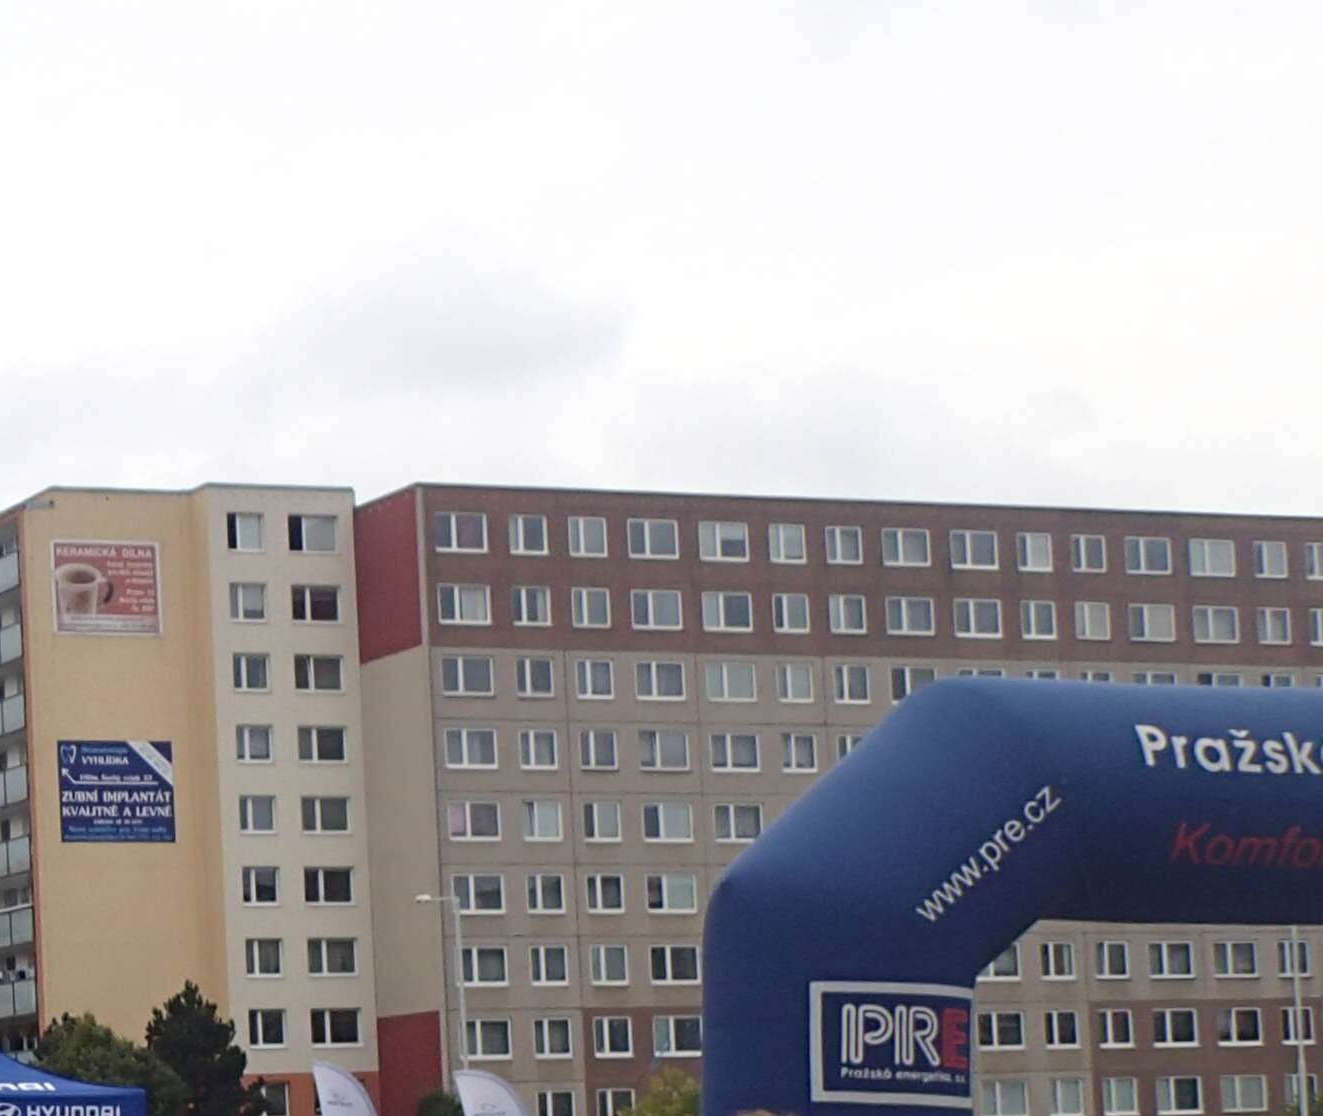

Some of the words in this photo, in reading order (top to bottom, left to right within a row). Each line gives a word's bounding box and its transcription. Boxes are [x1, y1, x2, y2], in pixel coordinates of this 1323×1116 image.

[1134, 723, 1322, 775] Pražsk
[62, 790, 98, 803] ZUBNÍ
[103, 790, 172, 803] IMPLANTÁT
[122, 806, 132, 817] A
[916, 785, 1061, 923] www.pre.cz
[841, 1003, 968, 1069] PRE
